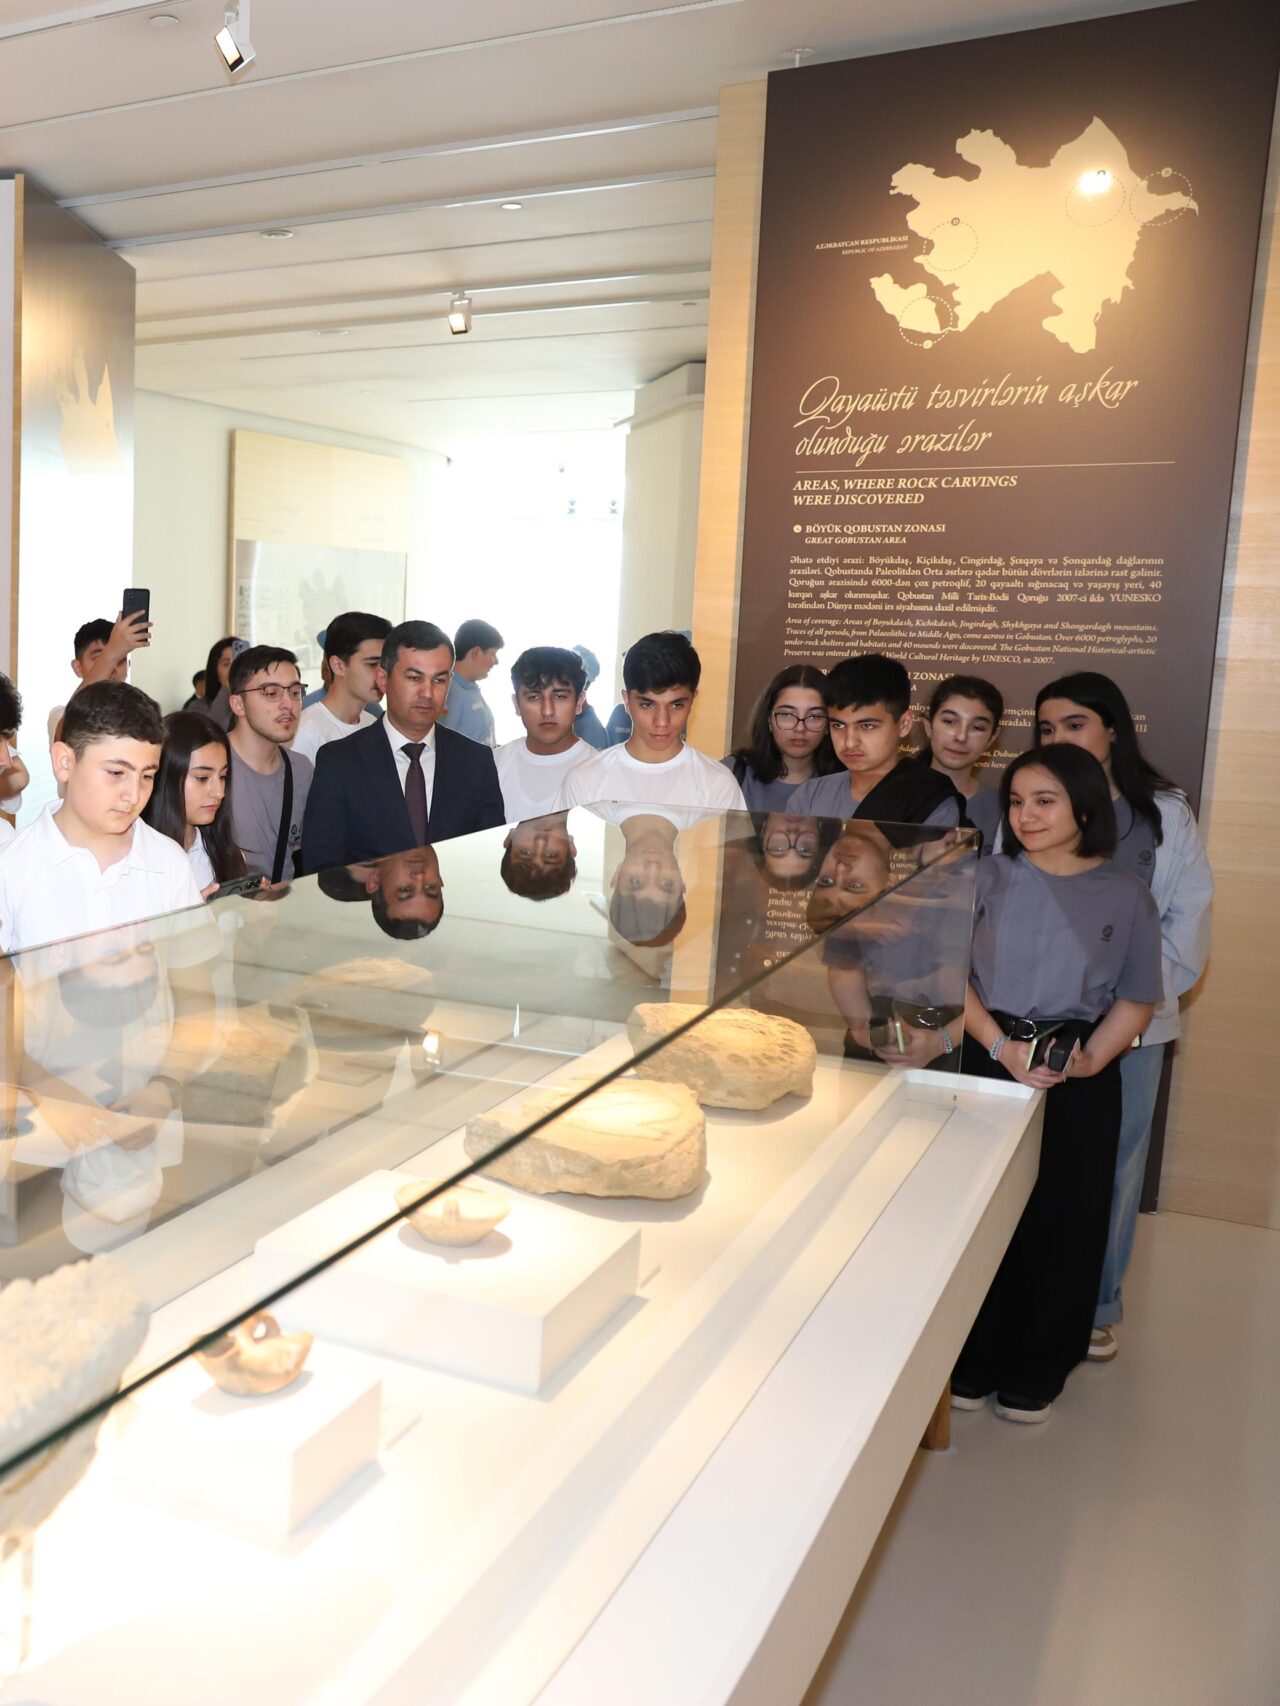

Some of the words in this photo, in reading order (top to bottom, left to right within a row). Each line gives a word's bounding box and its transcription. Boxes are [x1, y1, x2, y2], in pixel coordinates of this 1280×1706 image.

[792, 479, 840, 492] AREAS,
[843, 478, 895, 489] WHERE
[896, 476, 938, 489] ROCK
[940, 475, 1018, 488] CARVINGS
[793, 494, 832, 505] WERE
[833, 492, 925, 505] DISCOVERED
[805, 524, 842, 534] BÖYÜK
[843, 524, 903, 535] QOBUSTAN
[904, 524, 946, 533] ZONASI
[804, 536, 834, 544] GREAT
[834, 536, 882, 544] GOBUSTAN
[881, 536, 907, 544] AREA
